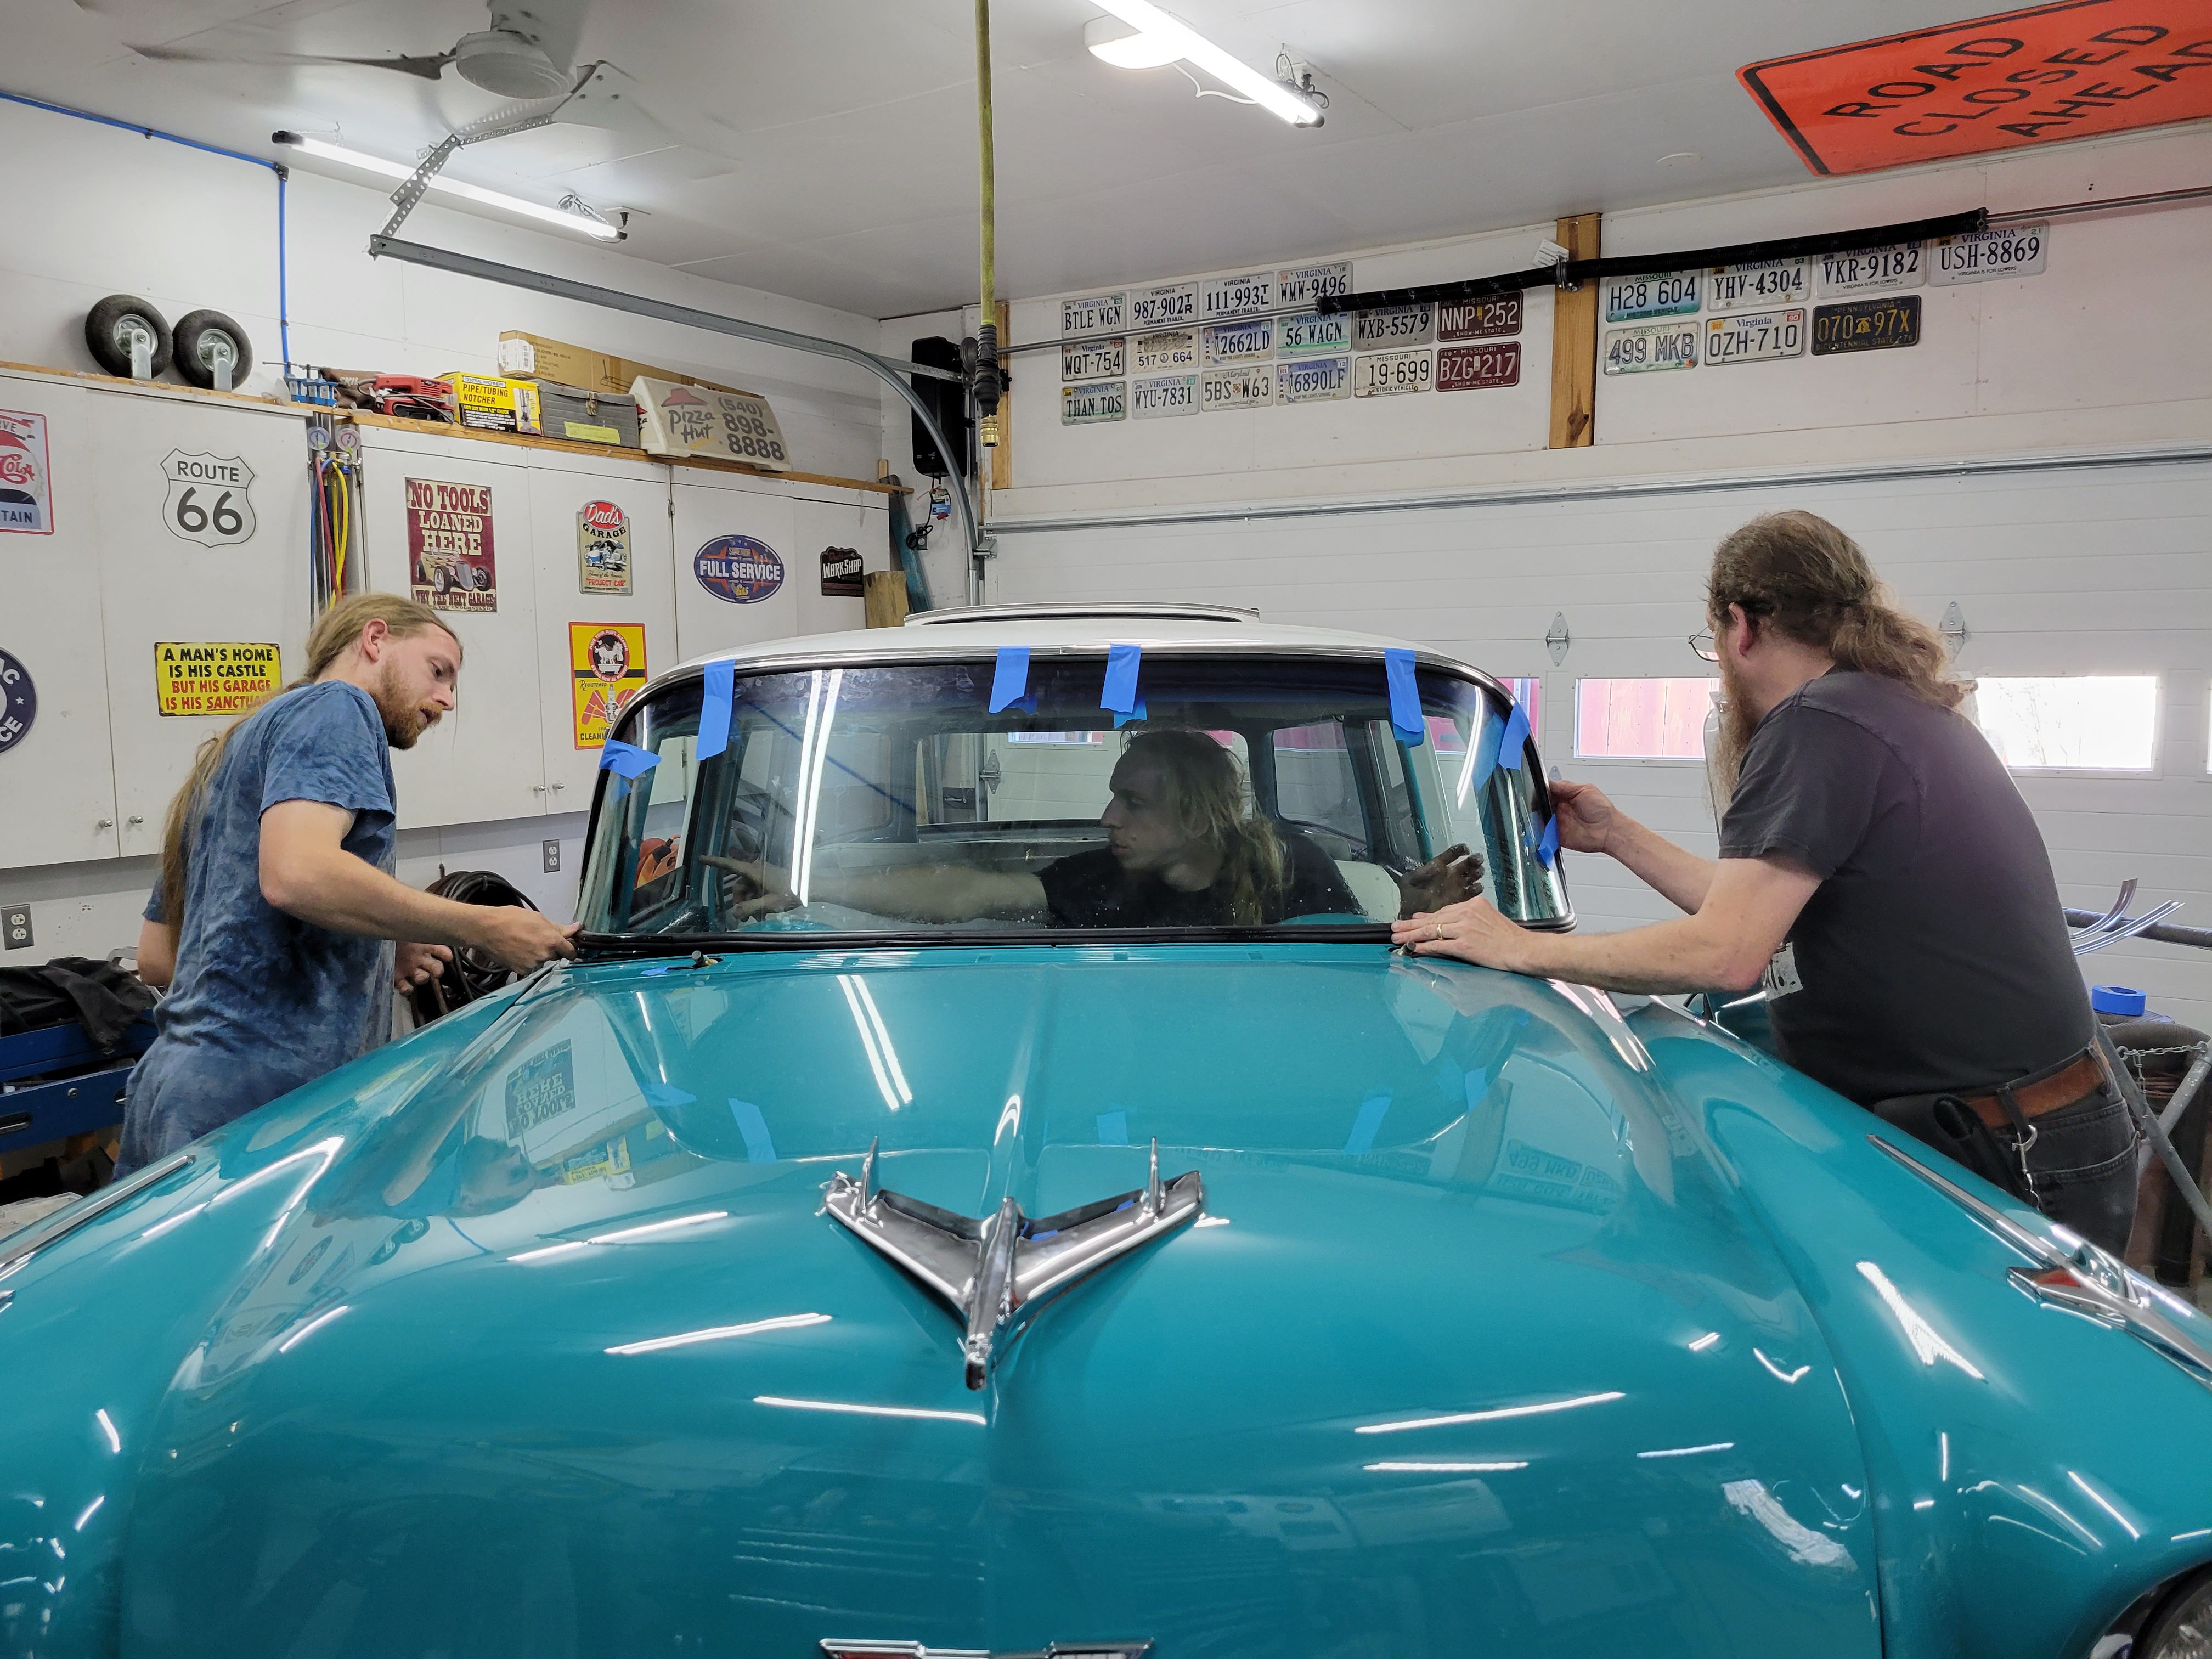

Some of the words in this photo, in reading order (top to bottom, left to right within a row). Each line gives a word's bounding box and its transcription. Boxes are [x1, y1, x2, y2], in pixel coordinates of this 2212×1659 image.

[1822, 37, 2024, 117] ROAD
[1894, 25, 2169, 136] CLOSED
[1996, 40, 2212, 137] AHEAD
[1962, 229, 2016, 242] VIRGINIA
[1845, 244, 1897, 257] VIRGINIA
[1941, 236, 2040, 270] USH-8869
[1296, 268, 1331, 279] VIRGINIA
[1735, 259, 1784, 272] VIRGINIA
[1824, 250, 1919, 285] VKR-9182
[1224, 278, 1250, 287] VIRGINIA
[1635, 272, 1673, 282] MISSOURI
[1714, 267, 1803, 300] YHV-4304
[1150, 288, 1176, 296] VIRGINIA
[1207, 286, 1260, 311] 111-993
[1280, 274, 1347, 302] WMW-9496
[1610, 284, 1647, 311] H28
[1658, 276, 1696, 305] 604
[1077, 299, 1108, 309] VIRGINIA
[1134, 296, 1184, 320] 987-902
[1463, 296, 1499, 304] MISSOURI
[1838, 302, 1894, 313] PENNSYLVANIA
[1065, 309, 1094, 330] BTLE
[1099, 306, 1121, 326] WGN
[1296, 314, 1331, 324] VIRGINIA
[1375, 305, 1413, 317] VIRGINIA
[1441, 306, 1475, 331] NNP
[1483, 301, 1518, 328] 252
[1223, 324, 1251, 332] VIRGINIA
[1358, 312, 1429, 340] WXB-5579
[1633, 326, 1670, 336] MISSOURI
[1736, 317, 1773, 328] Virginia
[1818, 315, 1854, 342] 070
[1874, 309, 1910, 336] 97X
[1220, 330, 1269, 354] 2662LD
[1285, 326, 1302, 347] 56
[1308, 321, 1342, 344] WAGN
[1872, 336, 1893, 345] STATE
[1138, 354, 1156, 366] 517
[1173, 351, 1192, 363] 664
[1376, 354, 1411, 363] MISSOURI
[1609, 338, 1646, 365] 499
[1655, 333, 1694, 362] MKB
[1065, 351, 1120, 375] WQT-754
[1369, 359, 1429, 387] 19-699
[1440, 357, 1474, 382] BZG
[1482, 352, 1516, 378] 217
[340, 377, 358, 386] SKIL
[483, 379, 504, 387] MACHINERY
[1149, 379, 1181, 388] VIRGINIA
[1223, 369, 1250, 379] Maryland
[1294, 369, 1345, 393] 6890LF
[463, 383, 509, 397] PIPE/TUBING
[464, 393, 495, 404] NOTCHER
[1079, 385, 1109, 395] VIRGINIA
[1135, 386, 1193, 409] WYU-7831
[1205, 380, 1231, 402] 5BS
[1242, 376, 1269, 398] W63
[718, 396, 763, 417] (540)
[1066, 397, 1095, 417] THAN
[1100, 394, 1122, 414] TOS
[681, 424, 713, 443] Hut
[722, 412, 774, 437] 898-
[726, 434, 785, 461] 8888
[177, 460, 240, 483] ROUTE
[412, 482, 434, 509] NO
[437, 485, 489, 514] TOOLS
[176, 486, 243, 535] 66
[587, 504, 621, 525] Dad's
[419, 511, 483, 532] LOANED
[583, 523, 626, 538] GARAGE
[422, 529, 482, 556] HERE
[700, 560, 729, 577] FULL
[732, 562, 781, 582] SERVICE
[823, 558, 862, 579] WORKSHOP
[416, 590, 430, 604] TRY
[449, 591, 466, 606] NEXT
[468, 592, 494, 607] GARAGE
[164, 648, 175, 661] A
[180, 648, 228, 661] MAN'S
[233, 648, 273, 661] HOME
[169, 664, 182, 678] IS
[188, 665, 212, 678] HIS
[217, 664, 266, 677] CASTLE
[172, 680, 195, 693] BUT
[200, 680, 219, 693] HIS
[223, 679, 271, 692] GARAGE
[166, 697, 178, 710] IS
[182, 697, 202, 709] HIS
